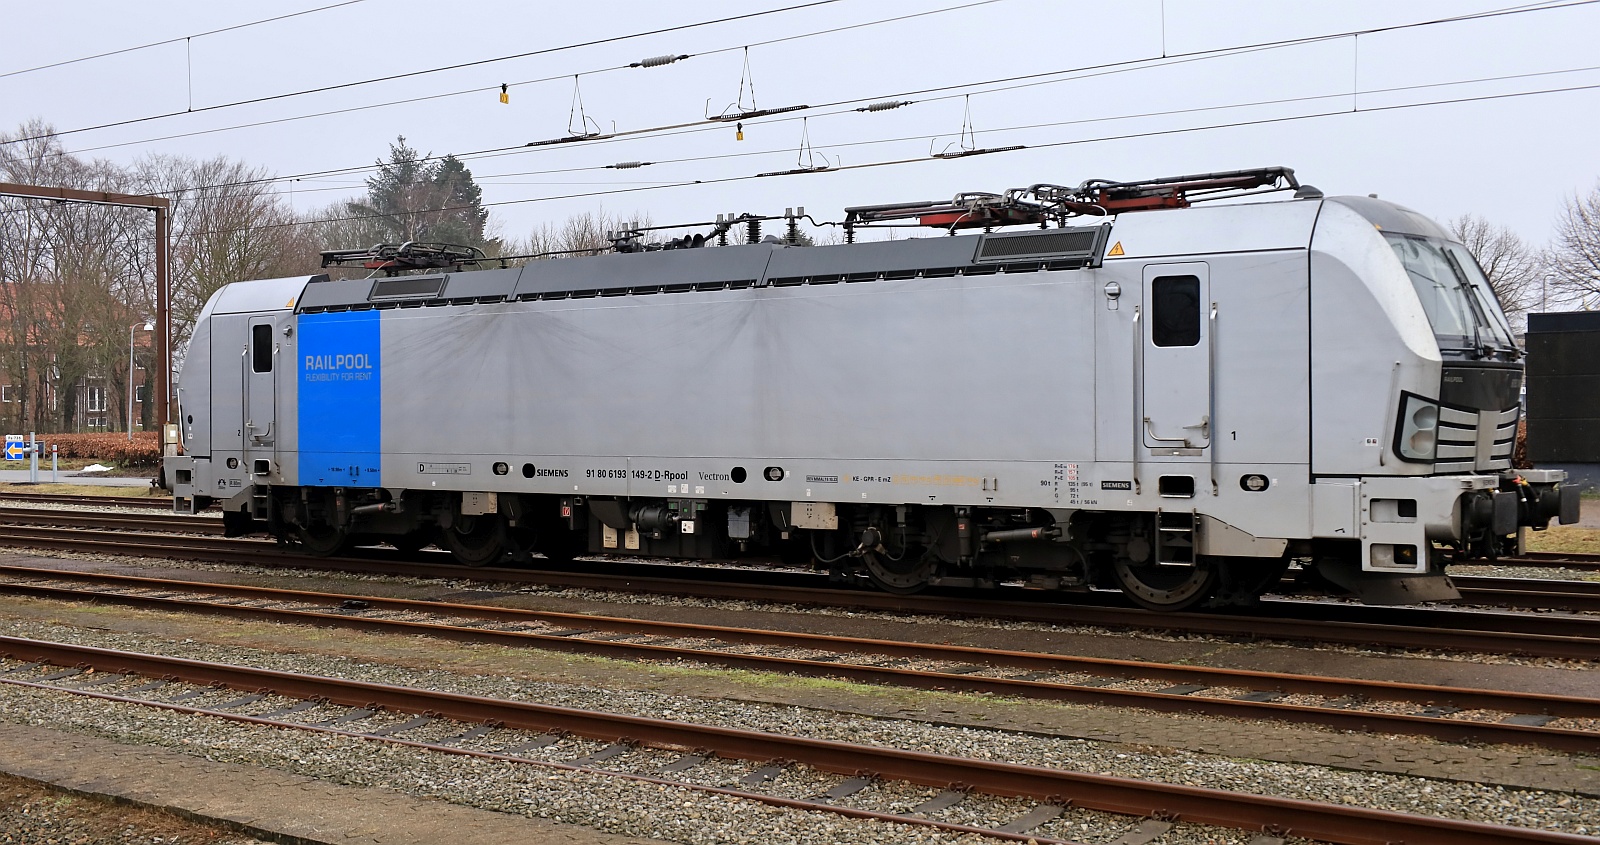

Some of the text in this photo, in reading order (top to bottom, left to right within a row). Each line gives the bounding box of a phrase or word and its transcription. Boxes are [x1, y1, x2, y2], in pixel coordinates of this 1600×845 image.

[306, 354, 372, 370] RAILPOOL
[306, 372, 372, 382] FLEXIBILITY FOR RENT
[1231, 431, 1236, 440] 1
[420, 464, 424, 472] D
[536, 468, 568, 478] SIEMENS
[586, 469, 688, 482] 91 80 6193 149-2 D-Rpool
[698, 472, 730, 481] Vectron
